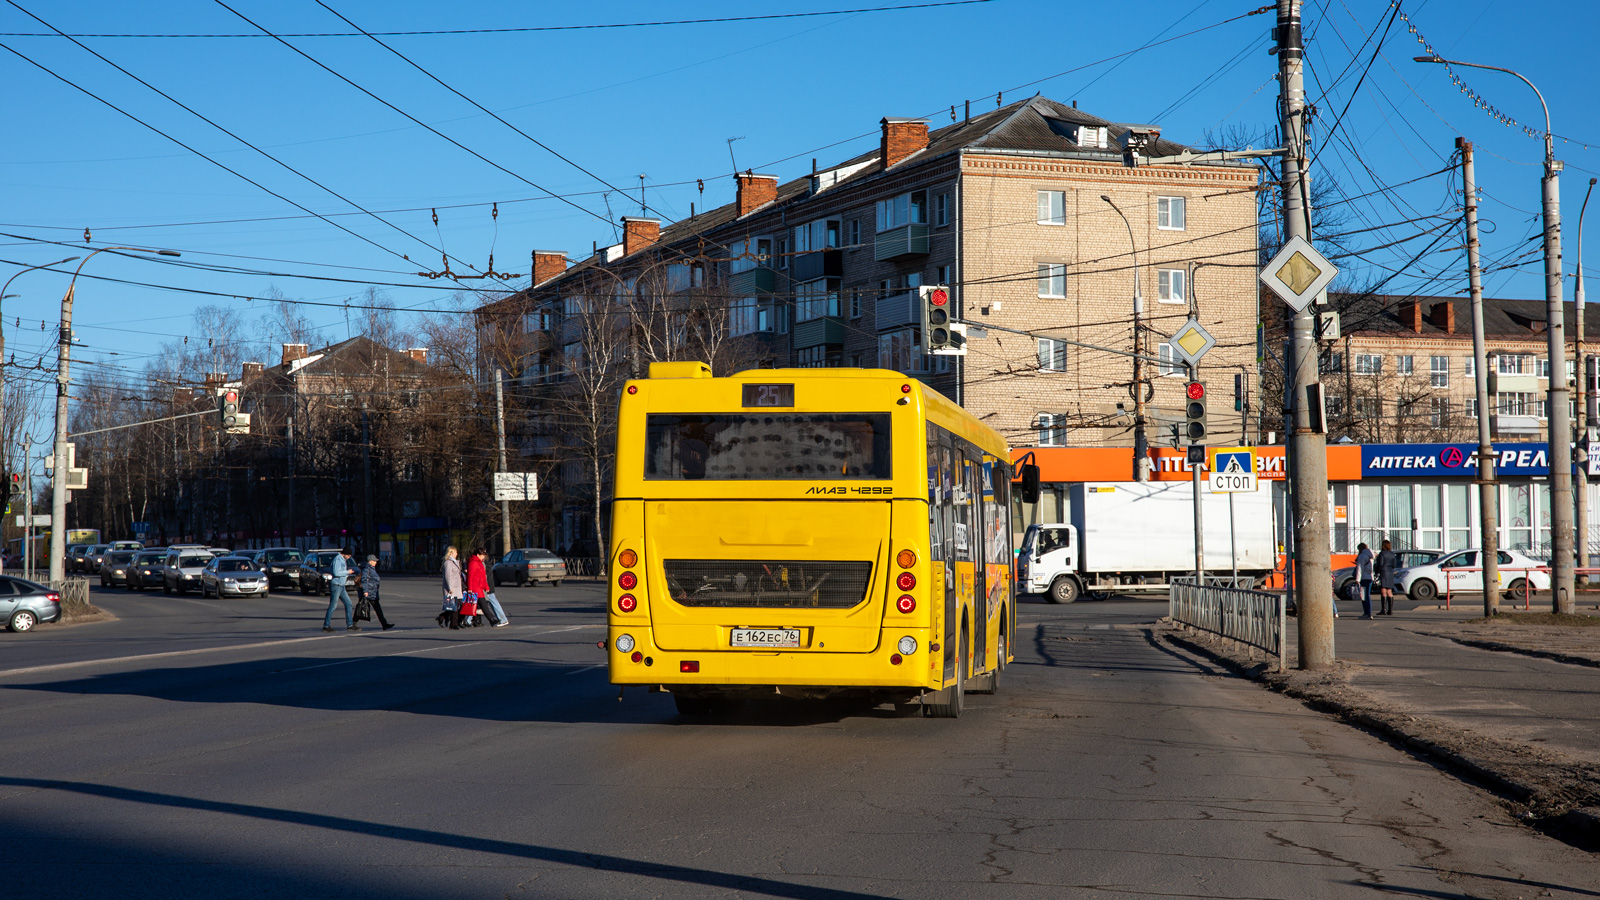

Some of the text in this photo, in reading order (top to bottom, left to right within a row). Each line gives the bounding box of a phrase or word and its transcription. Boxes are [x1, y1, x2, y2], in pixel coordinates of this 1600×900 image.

[758, 385, 779, 406] 25
[1148, 456, 1286, 472] АПТЕ ВИТ
[1369, 456, 1436, 468] АПТЕКА
[1463, 450, 1550, 468] АРЕЛ
[1215, 476, 1250, 489] СТОП
[805, 486, 893, 495] ЛИАЗ 4292
[784, 631, 796, 640] 76
